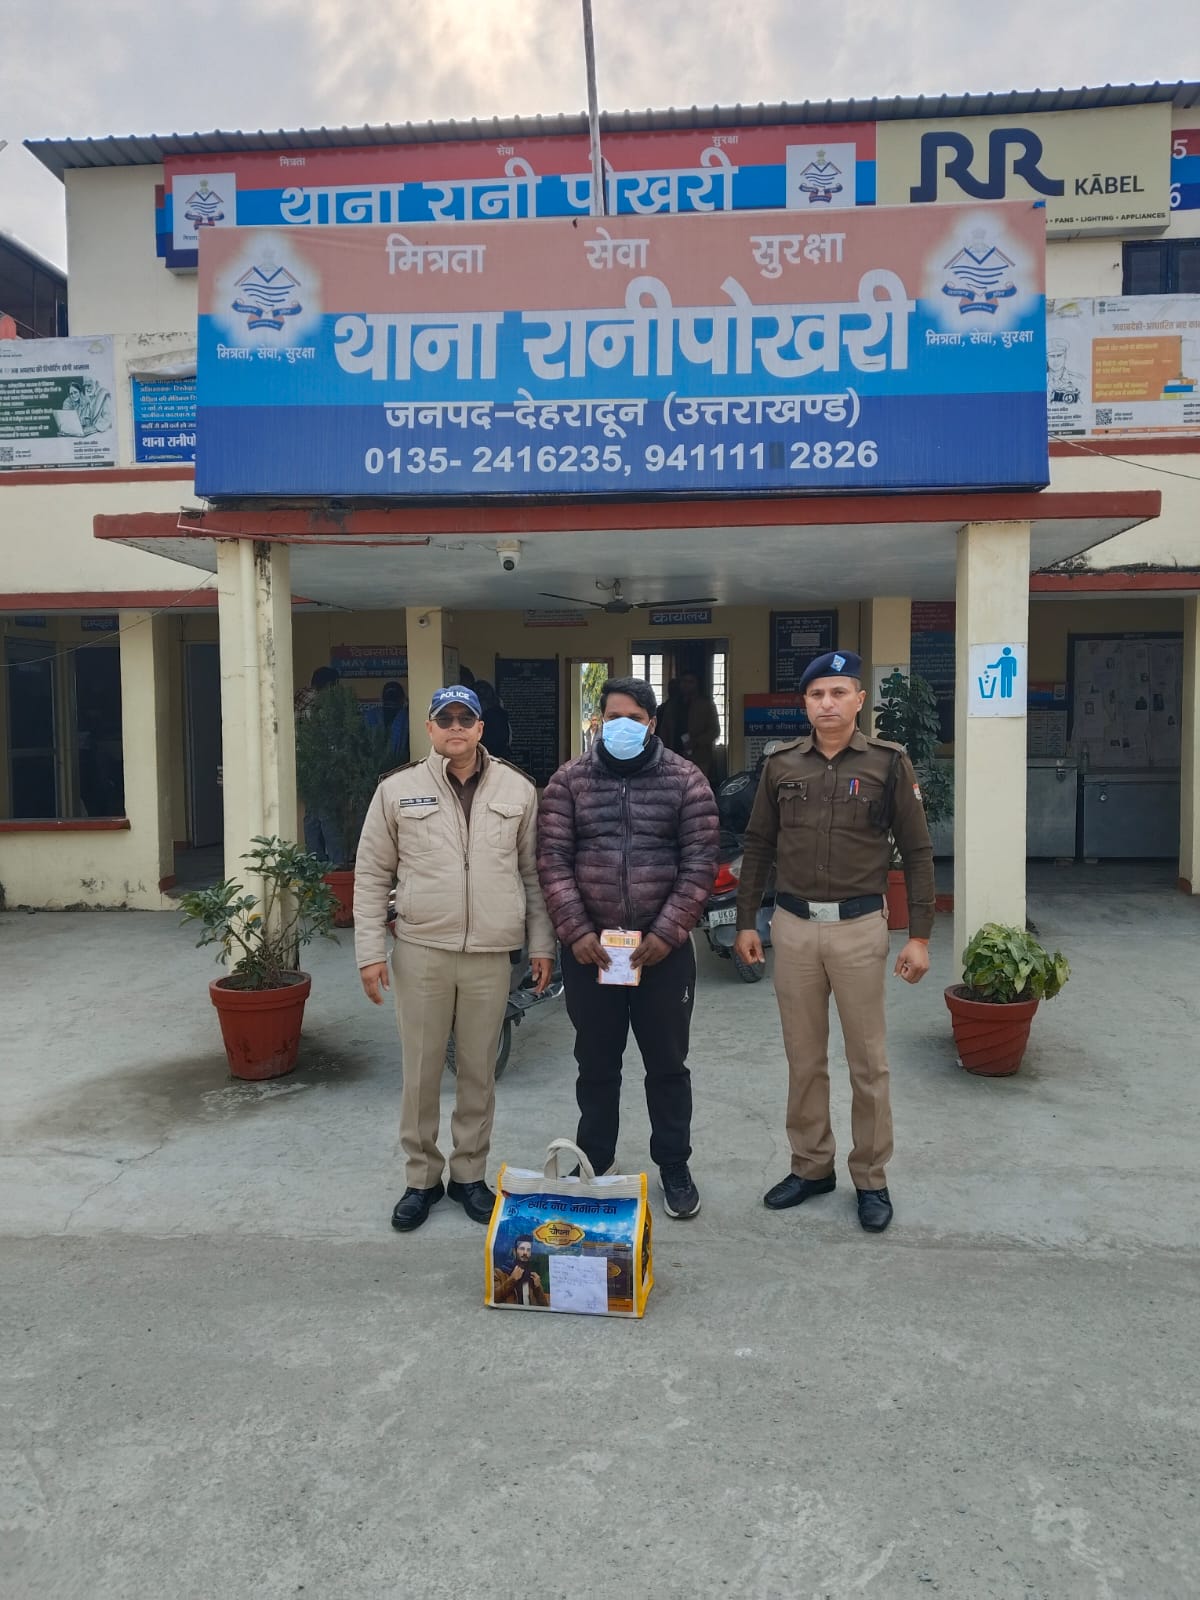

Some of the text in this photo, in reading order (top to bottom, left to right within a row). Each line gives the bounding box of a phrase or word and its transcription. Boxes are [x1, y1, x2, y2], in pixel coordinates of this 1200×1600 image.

[909, 127, 1065, 204] RR
[279, 182, 405, 225] थाना
[422, 157, 542, 222] रानी
[1080, 215, 1114, 223] LIGHTING
[1120, 212, 1166, 220] APPLIANCES
[385, 233, 487, 275] मित्रता
[584, 227, 650, 270] सेवा
[749, 232, 847, 279] सुरक्षा
[333, 268, 917, 382] थाना रानीपोखरी
[924, 327, 1034, 348] मित्रता, सेवा, सुरक्षा
[216, 343, 316, 364] मित्रता, सेवा, सुरक्षा
[383, 386, 861, 439] जनपद-देहरादून (उत्तराखण्ड)
[142, 432, 197, 448] थाना रानीपो
[364, 446, 462, 474] 0135-
[471, 444, 632, 477] 2416235,
[439, 690, 471, 701] POLICE
